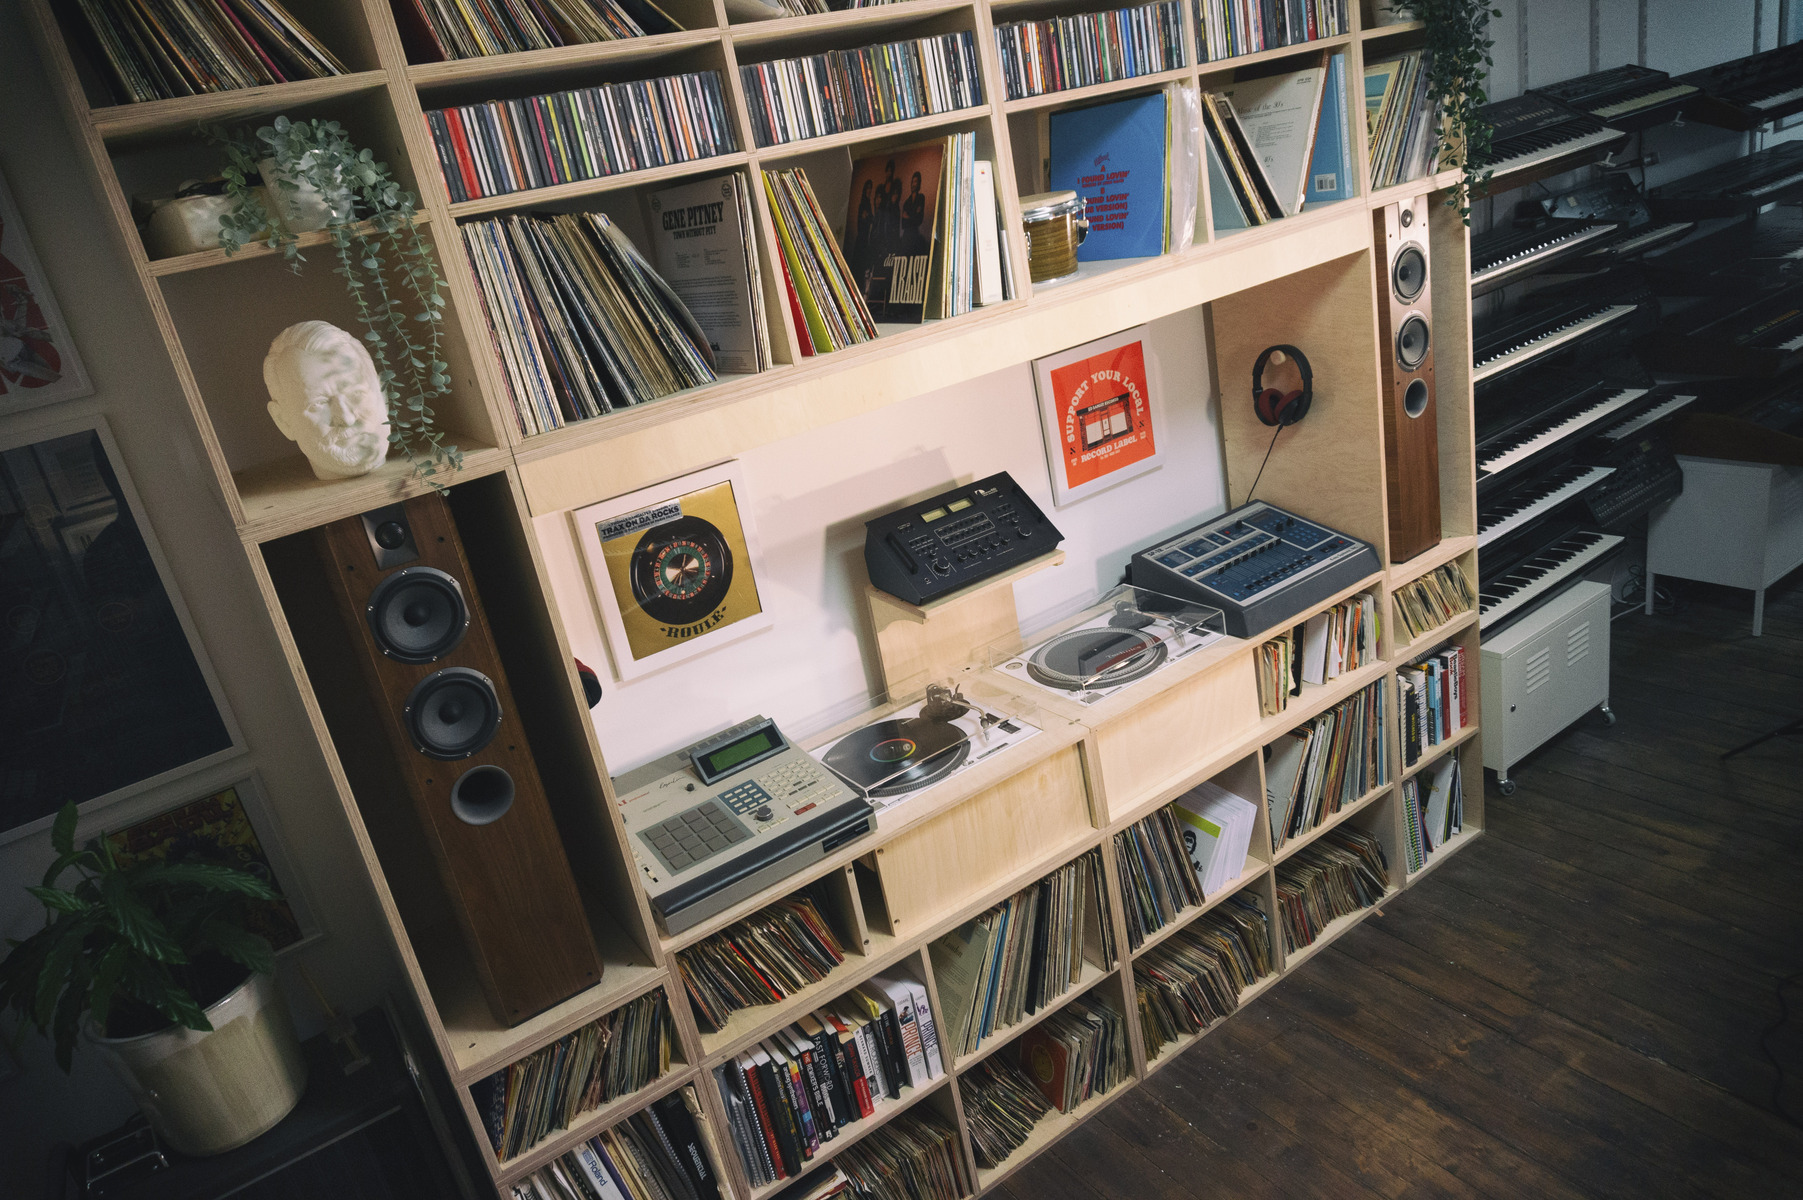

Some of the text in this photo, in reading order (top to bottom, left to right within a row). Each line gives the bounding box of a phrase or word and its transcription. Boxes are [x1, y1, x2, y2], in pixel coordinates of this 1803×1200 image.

[1082, 174, 1105, 183] FOUND
[1107, 170, 1130, 180] LOVIN'
[1096, 202, 1128, 212] VERSION)
[1106, 193, 1129, 202] LOVIN'
[663, 208, 686, 231] GENE
[687, 202, 724, 227] PITNEY
[1092, 222, 1124, 231] VERSION)
[1106, 212, 1129, 221] LOVIN'
[889, 255, 928, 304] KRASH
[1066, 380, 1089, 443] SUPPORT
[1091, 370, 1121, 383] YOUR
[601, 524, 626, 535] TRAX
[626, 519, 638, 527] ON
[652, 506, 679, 519] ROCKS
[812, 1035, 823, 1053] FAST
[901, 1021, 922, 1059] PRINCE
[921, 1020, 938, 1050] PRINCE
[802, 1052, 811, 1064] THE
[781, 1066, 799, 1110] analog synthesizers
[805, 1062, 819, 1091] REMIXER'S
[813, 1090, 823, 1107] BIBLE
[589, 1160, 608, 1187] Roland
